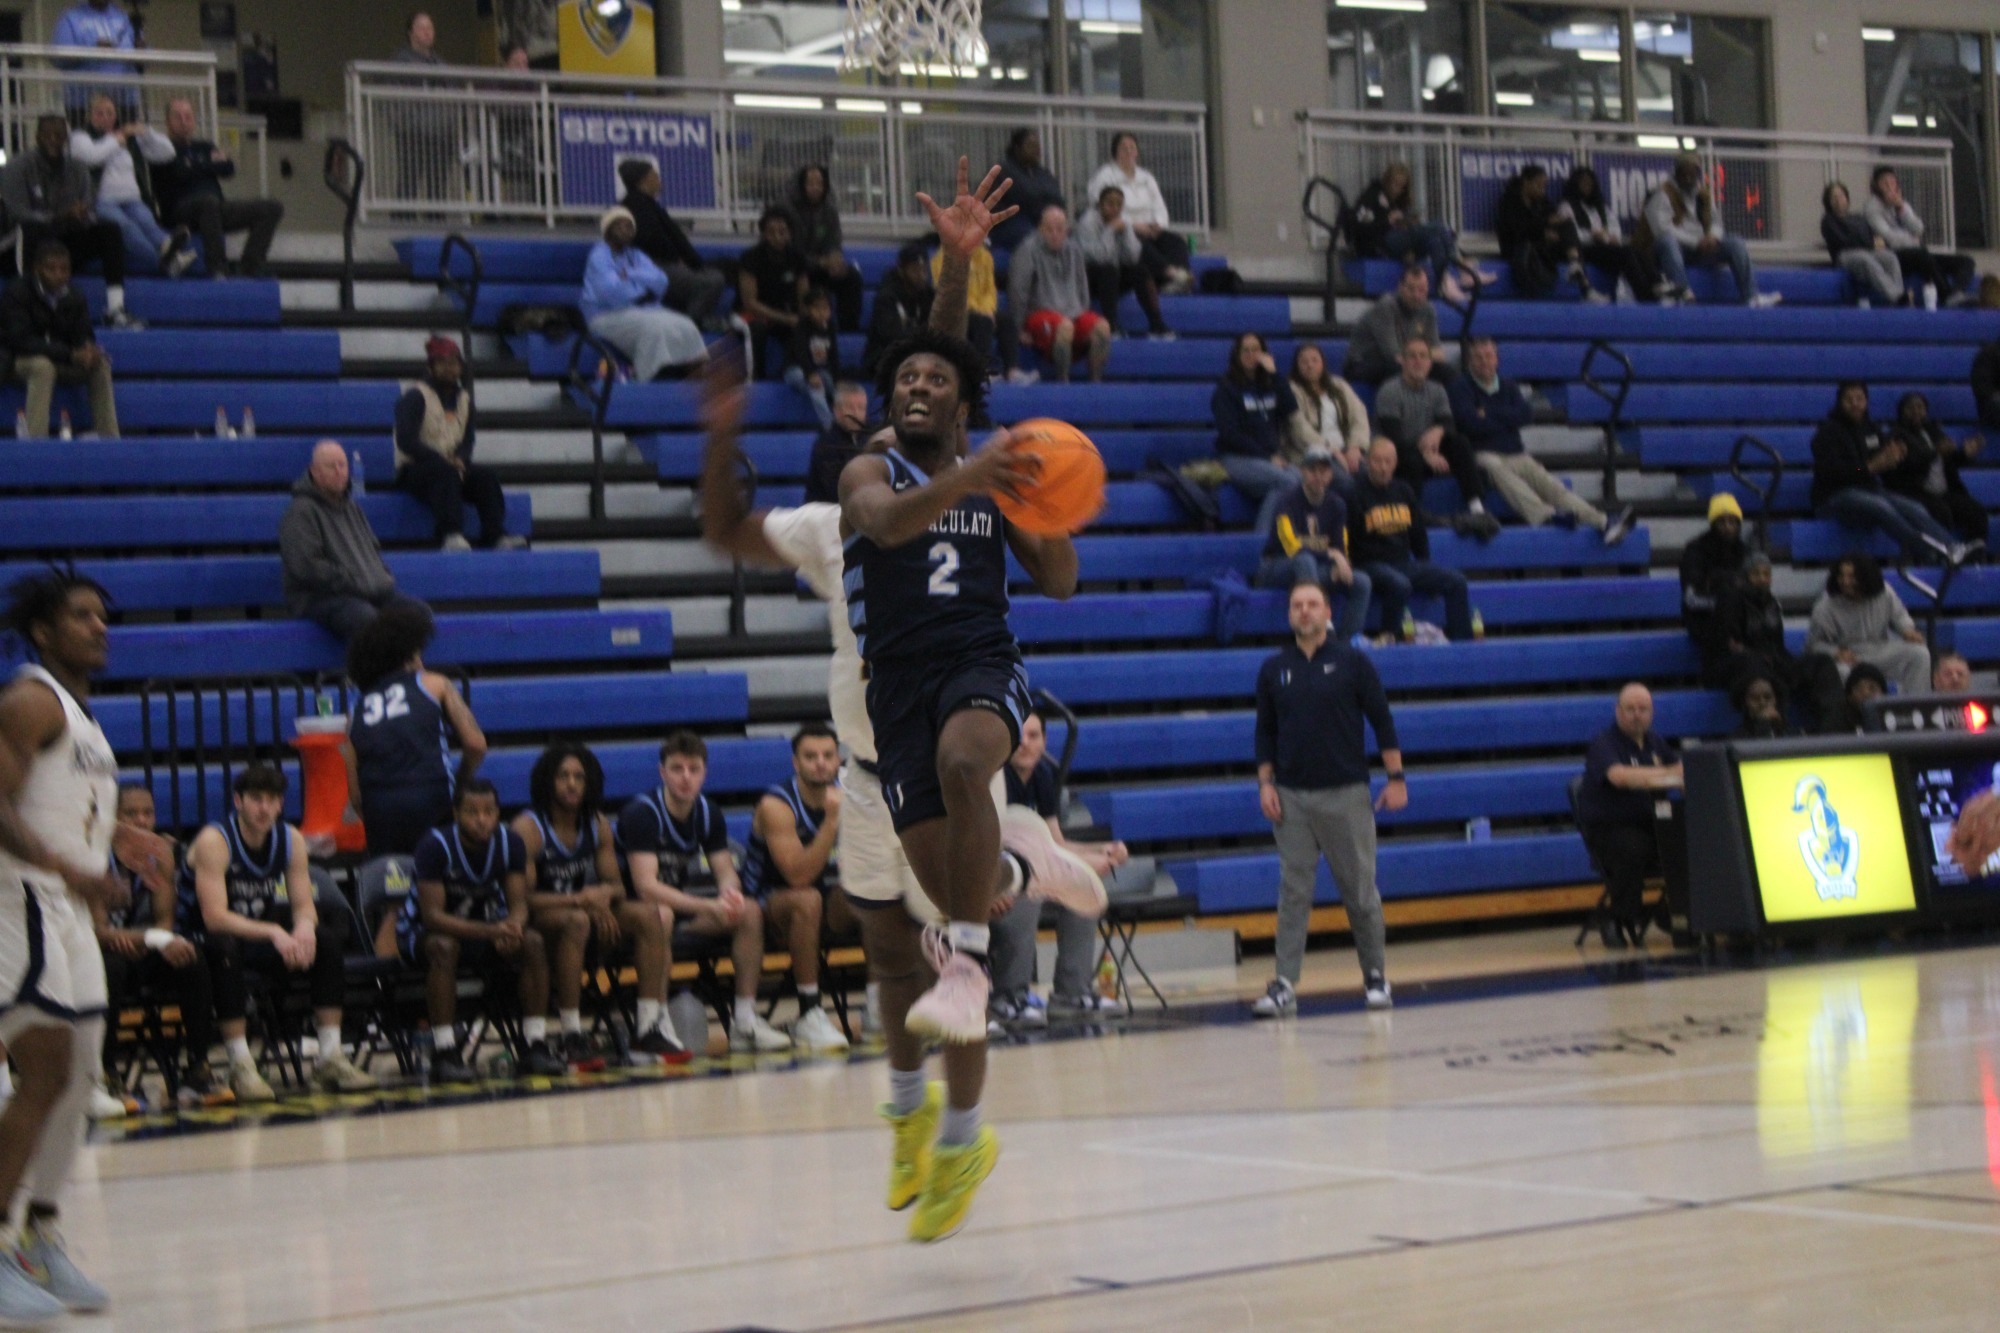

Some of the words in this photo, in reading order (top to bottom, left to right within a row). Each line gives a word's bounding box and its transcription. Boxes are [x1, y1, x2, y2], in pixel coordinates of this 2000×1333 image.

[562, 115, 708, 148] SECTION
[927, 541, 960, 596] 2
[363, 682, 411, 727] 32
